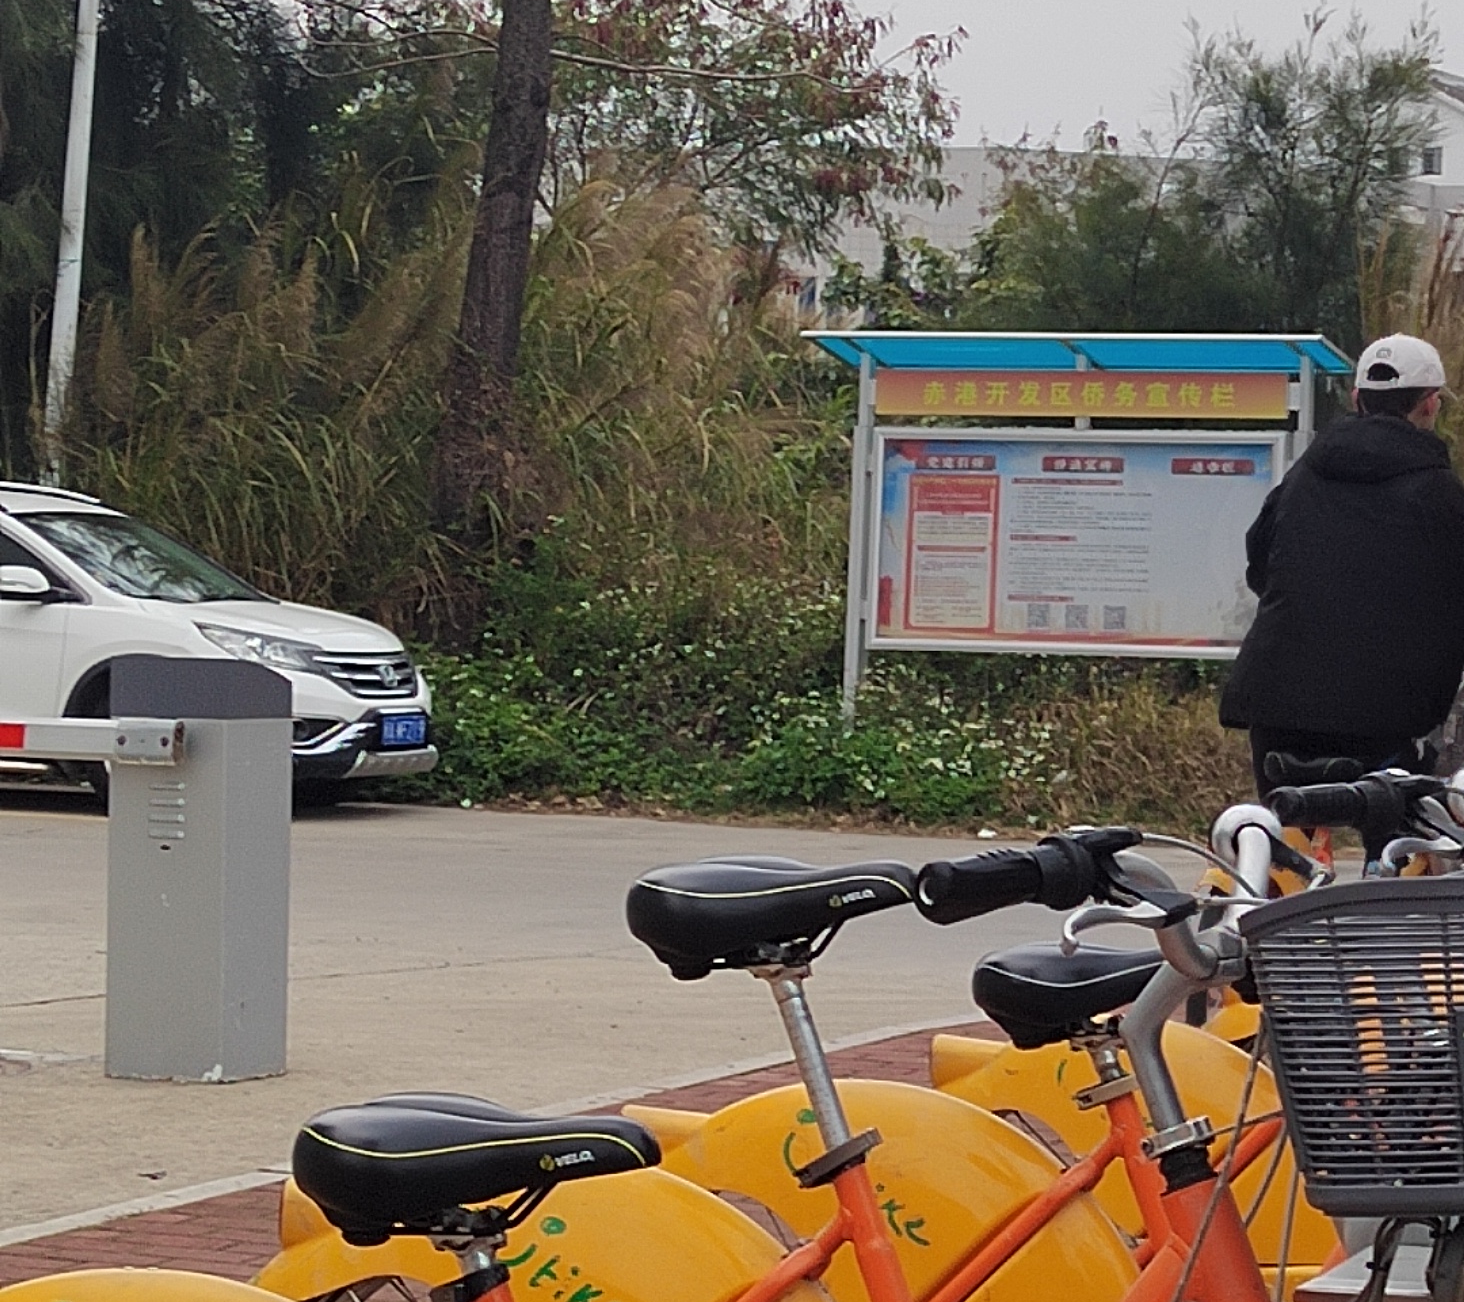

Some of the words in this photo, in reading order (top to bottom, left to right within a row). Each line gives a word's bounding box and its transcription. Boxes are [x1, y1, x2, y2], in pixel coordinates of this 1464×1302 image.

[923, 381, 1236, 408] 赤港开发区侨务宣传栏
